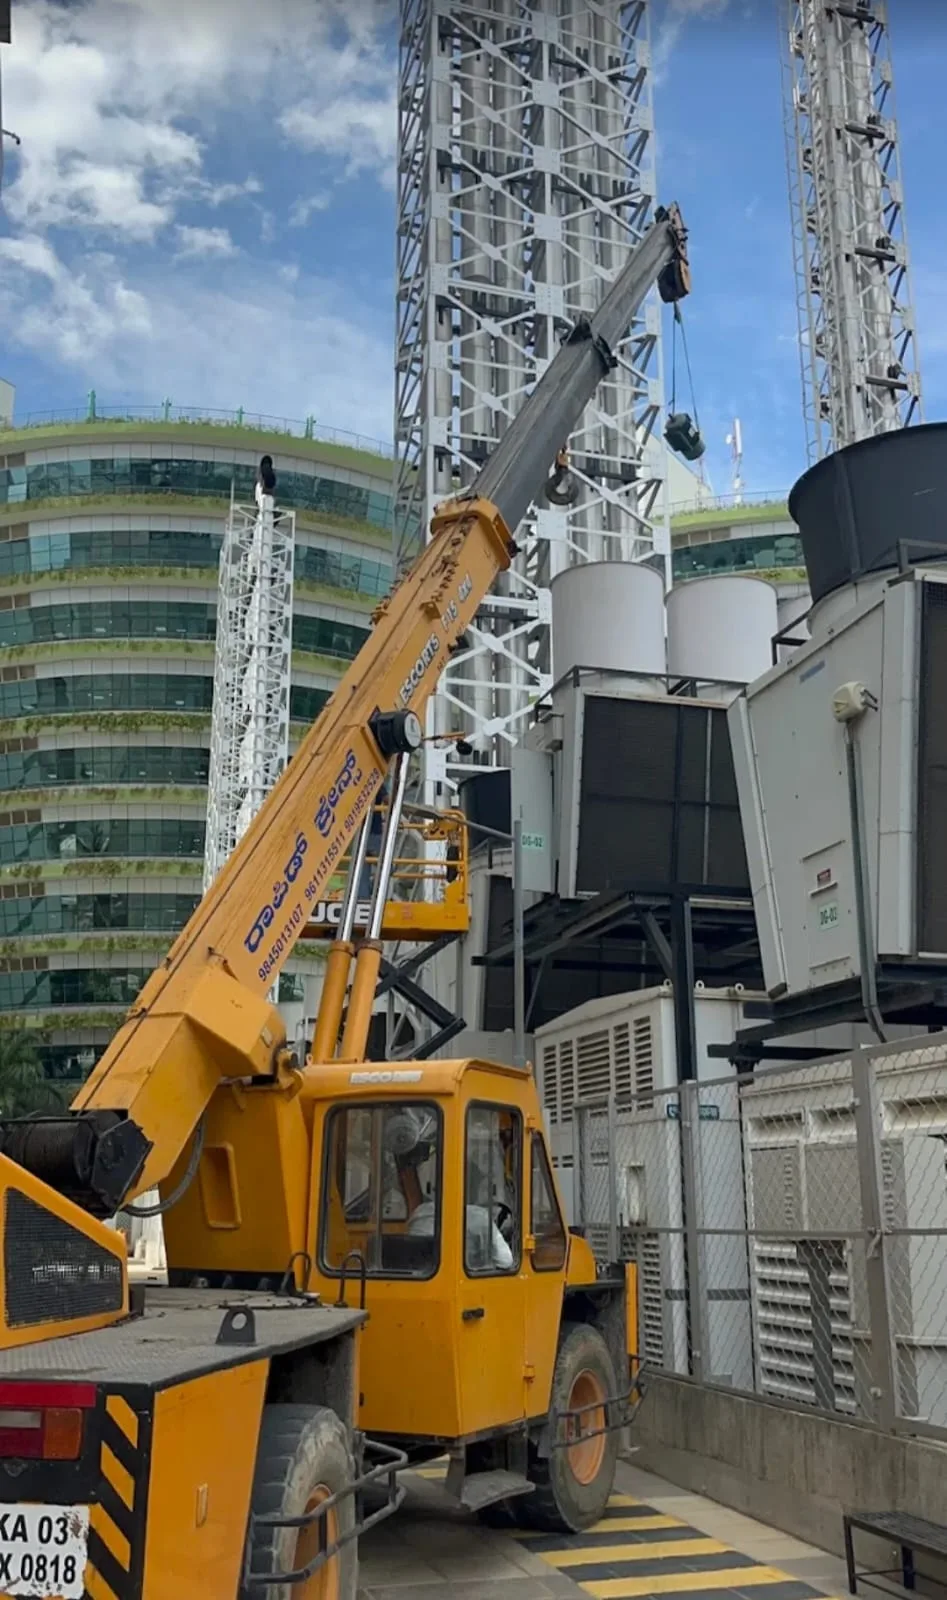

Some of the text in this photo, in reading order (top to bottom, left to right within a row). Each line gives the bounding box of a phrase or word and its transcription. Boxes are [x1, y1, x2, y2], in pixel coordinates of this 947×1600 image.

[400, 633, 440, 704] ESCORTS
[257, 903, 305, 983] 9845013107
[304, 831, 347, 902] 9611315511
[38, 1516, 68, 1545] 03
[20, 1553, 76, 1584] 0818
